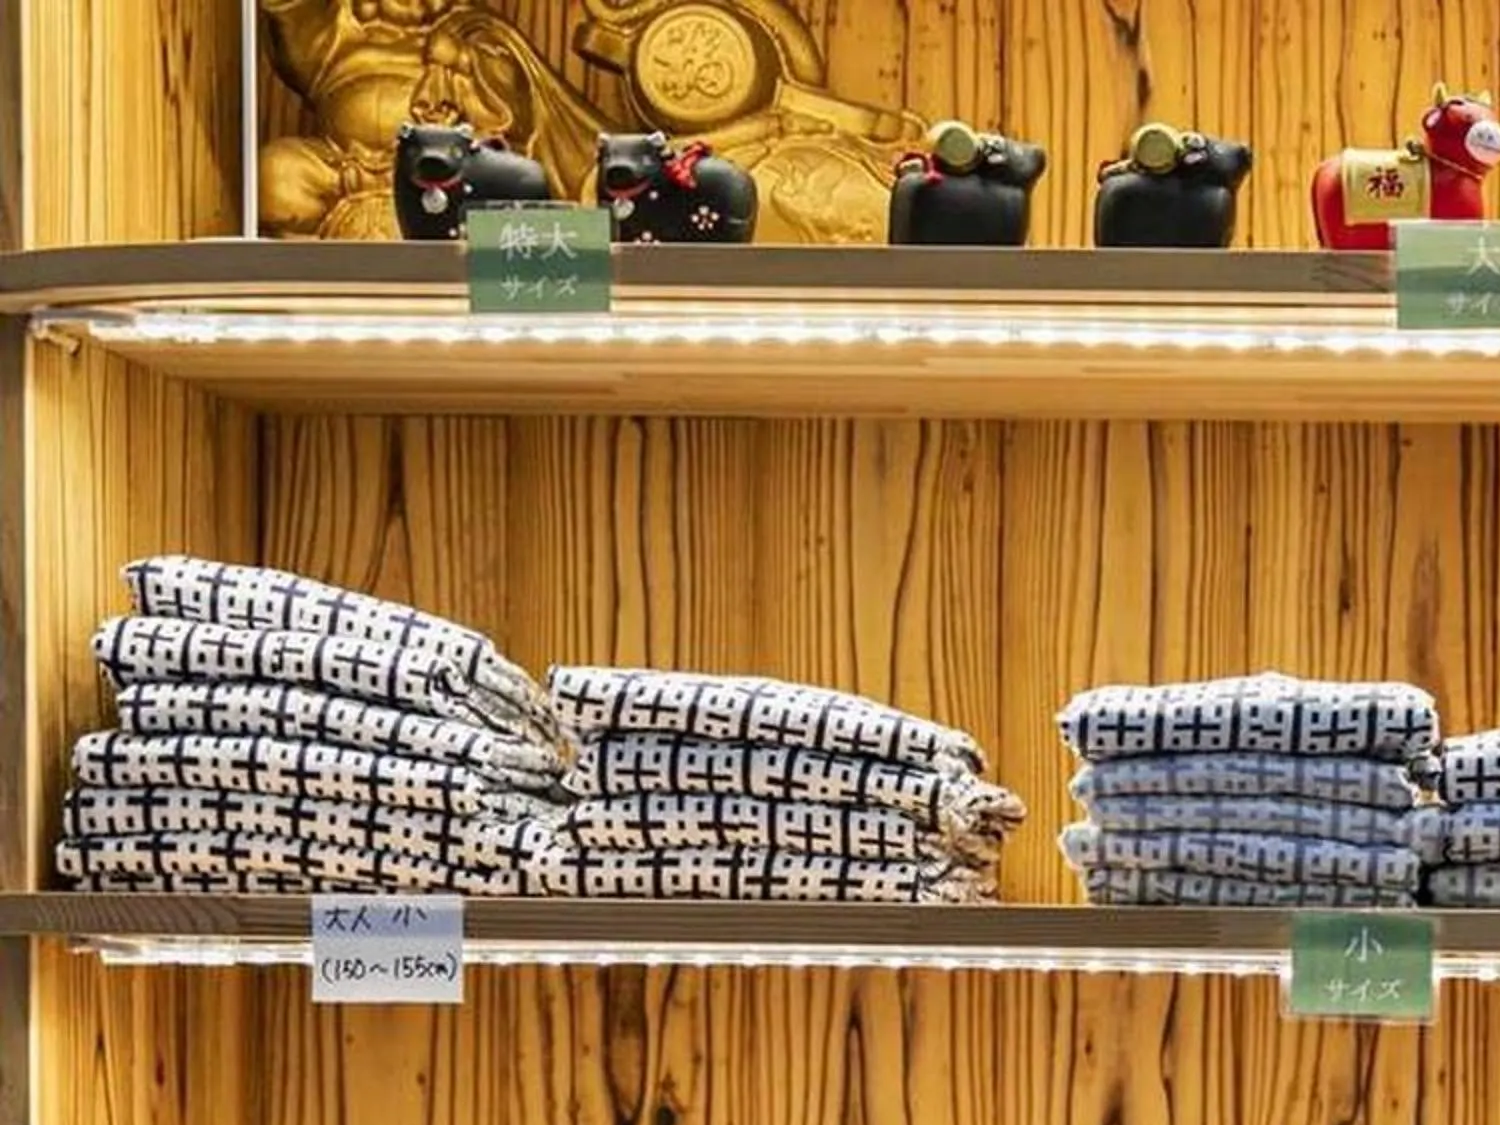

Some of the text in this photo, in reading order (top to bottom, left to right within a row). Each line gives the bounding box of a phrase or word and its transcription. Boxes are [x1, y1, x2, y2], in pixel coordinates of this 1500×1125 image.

[1368, 166, 1404, 199] 福
[499, 222, 578, 261] 特大
[500, 274, 578, 300] サイズ
[324, 905, 427, 932] 大人 小
[1344, 926, 1383, 962] 小
[1325, 979, 1402, 1003] サイズ
